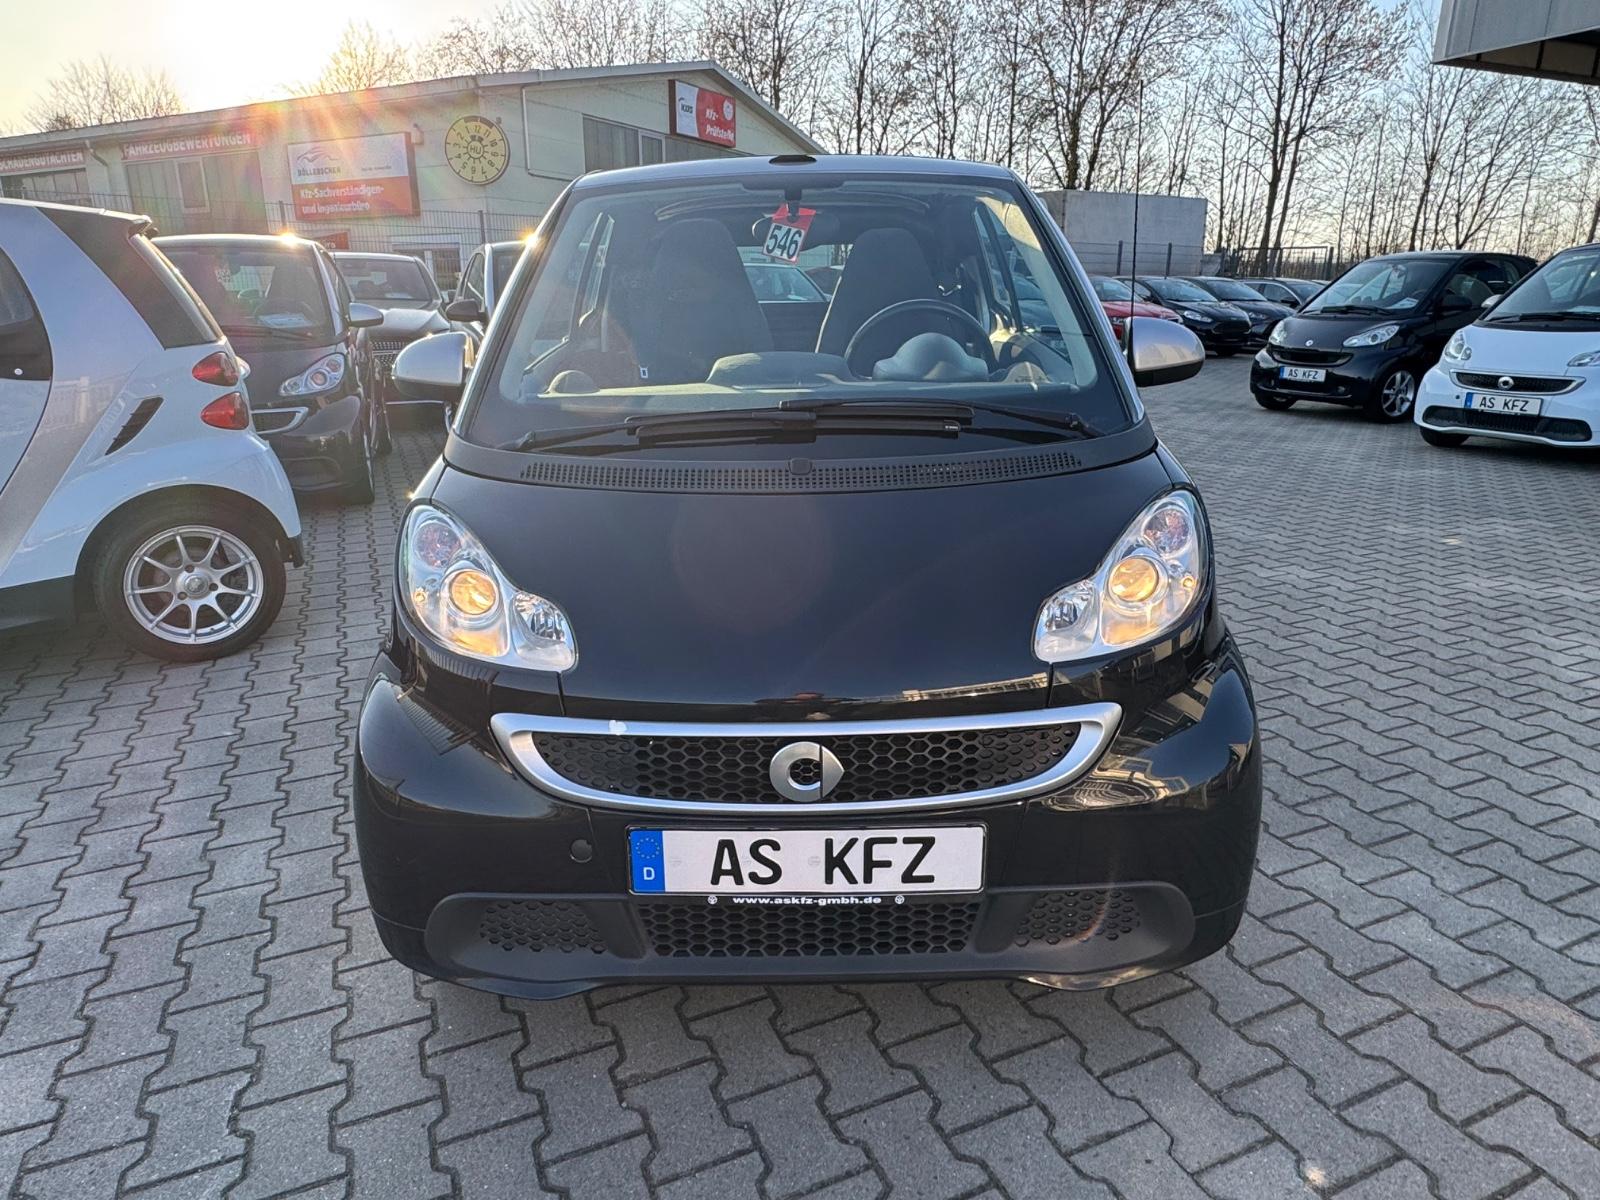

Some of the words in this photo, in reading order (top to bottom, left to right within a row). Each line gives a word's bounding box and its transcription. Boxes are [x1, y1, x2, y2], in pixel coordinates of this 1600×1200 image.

[124, 134, 251, 157] FAHRZEUGBEWERTUNGEN
[469, 145, 482, 155] HU
[765, 225, 802, 260] 546
[1288, 368, 1298, 378] AS
[1302, 370, 1319, 380] KFZ
[1479, 396, 1496, 409] AS
[1502, 398, 1530, 412] KFZ
[709, 838, 783, 886] AS
[824, 836, 936, 885] KFZ
[643, 867, 655, 881] D
[732, 895, 882, 906] www.askfz-gmbh.de
